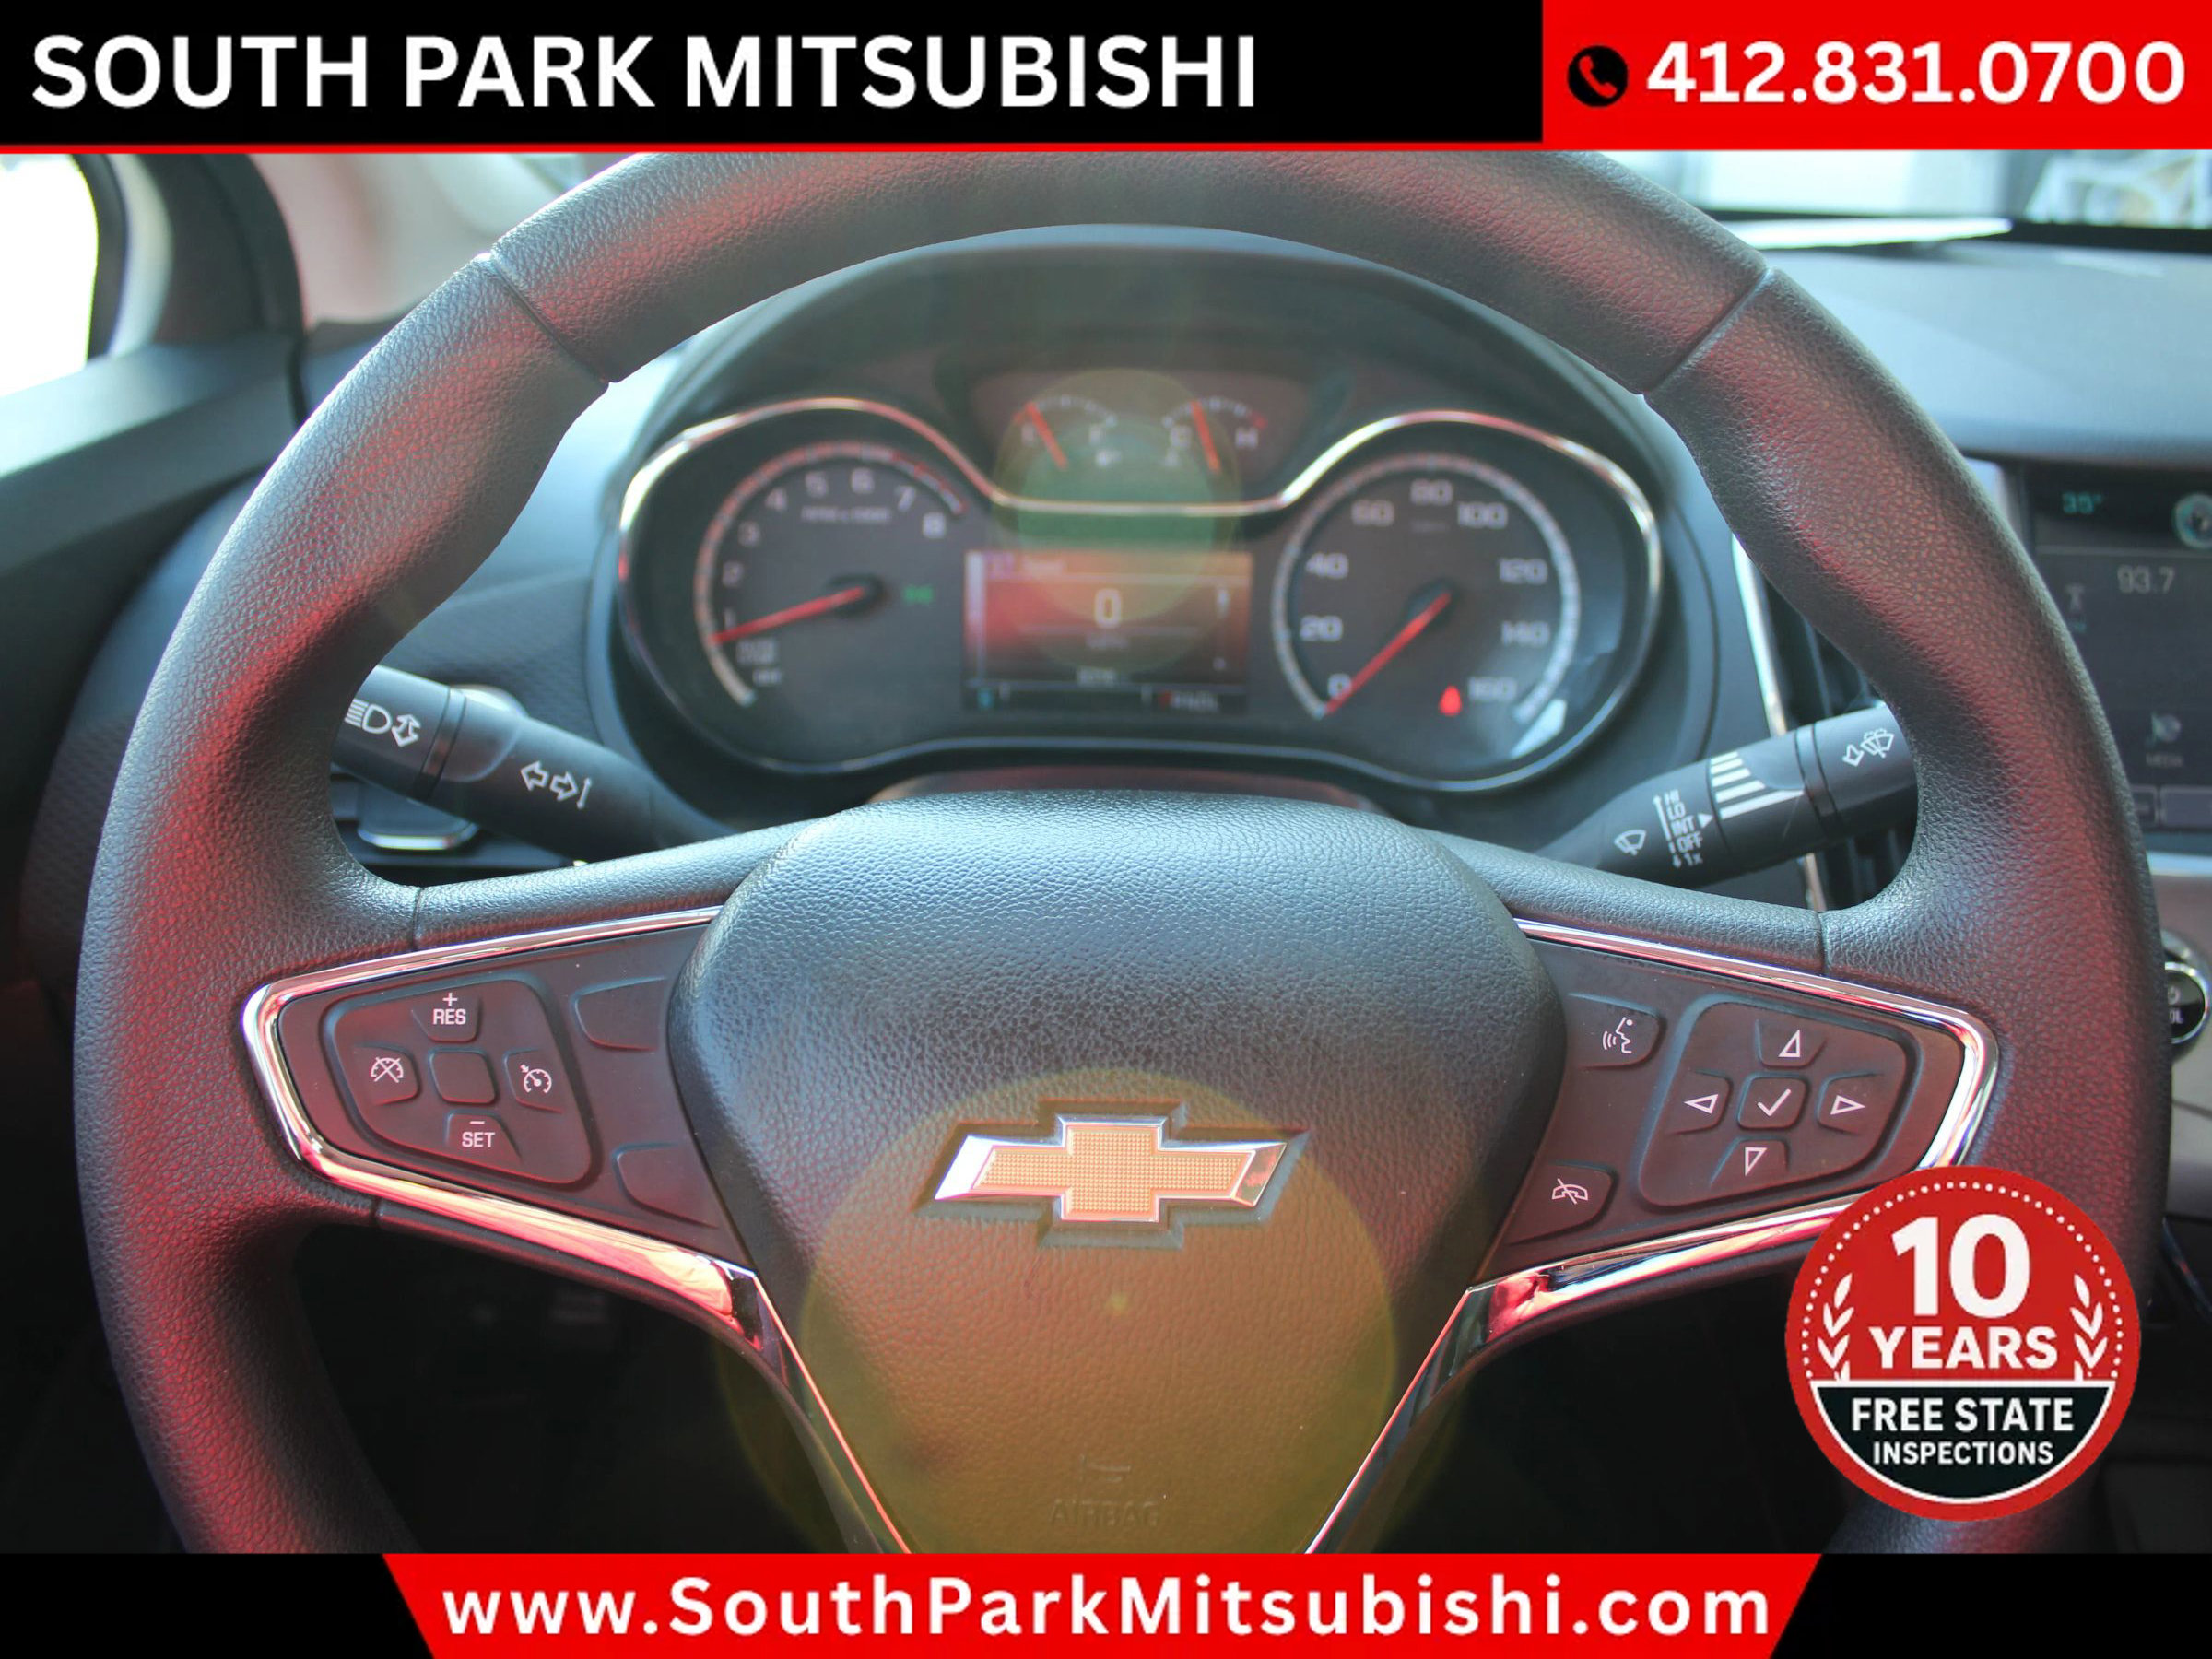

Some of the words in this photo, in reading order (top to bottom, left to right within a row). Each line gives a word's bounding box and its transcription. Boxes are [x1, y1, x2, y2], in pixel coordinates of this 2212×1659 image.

[1410, 479, 1453, 506] 80
[1457, 502, 1509, 529] 100
[1306, 553, 1348, 579] 40
[1499, 558, 1548, 585] 120
[1093, 588, 1123, 629] 0
[1300, 615, 1343, 642] 20
[1677, 830, 1702, 853] OFF
[432, 1008, 466, 1025] RES
[462, 1131, 496, 1148] SET
